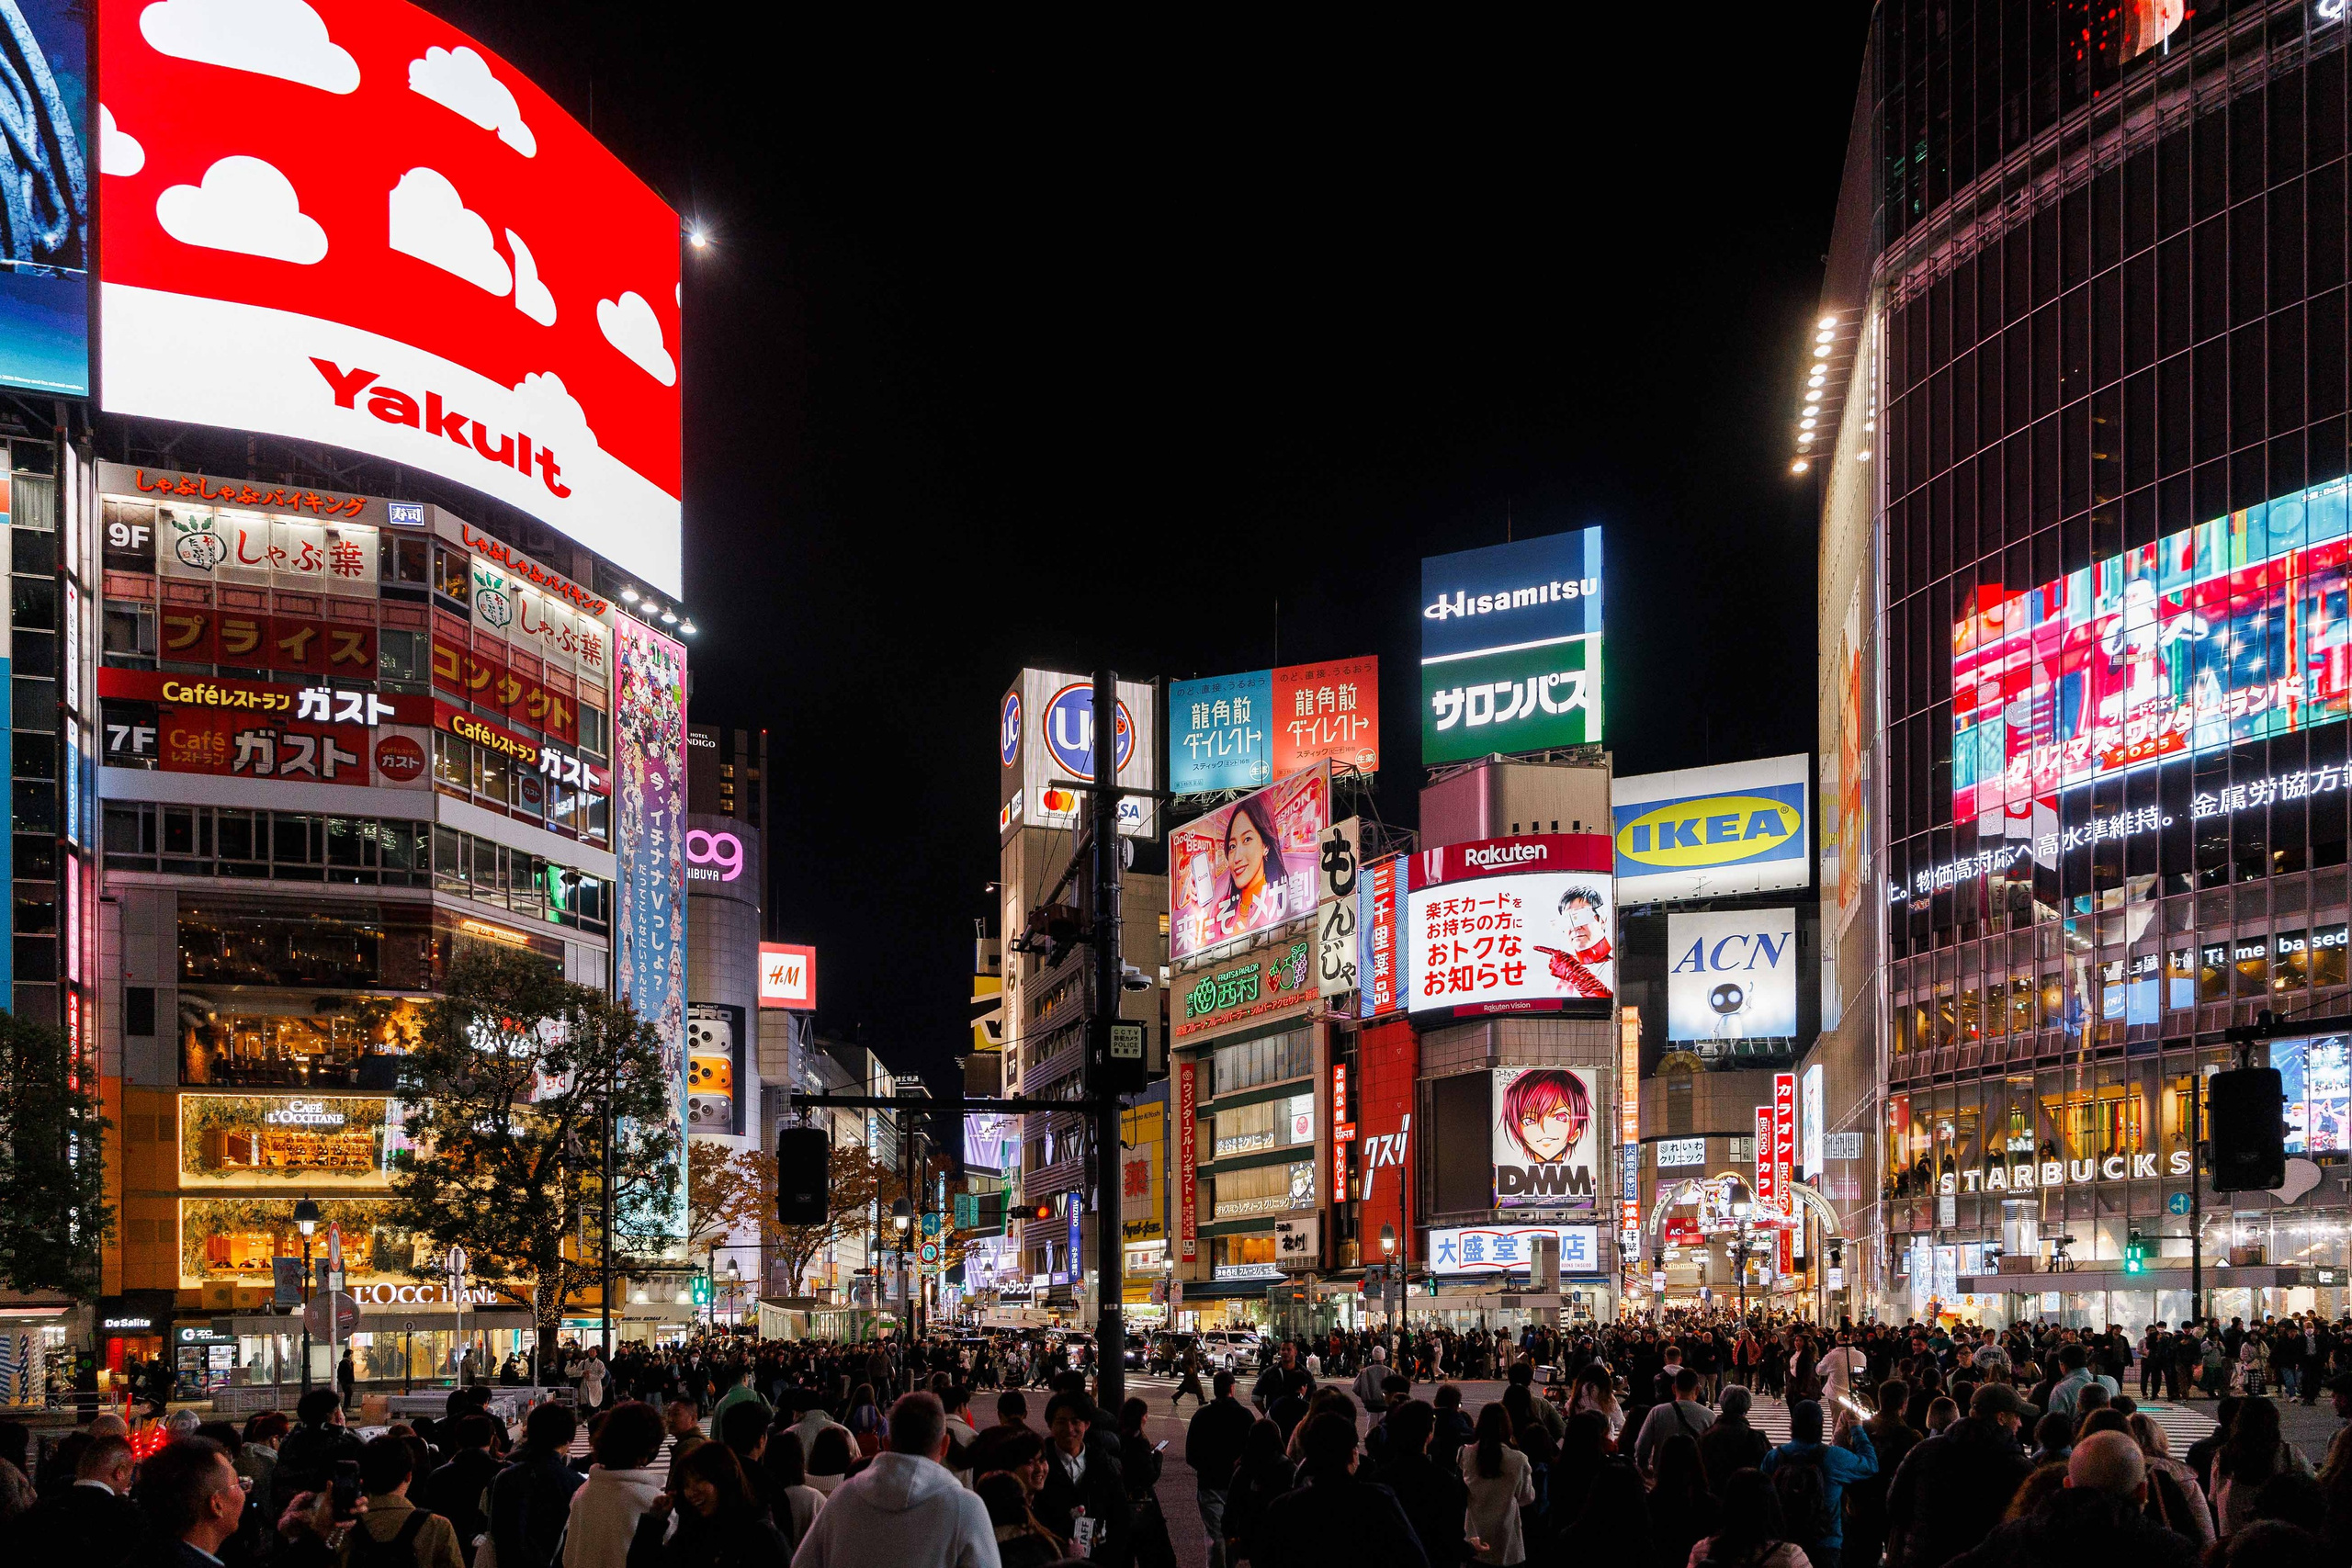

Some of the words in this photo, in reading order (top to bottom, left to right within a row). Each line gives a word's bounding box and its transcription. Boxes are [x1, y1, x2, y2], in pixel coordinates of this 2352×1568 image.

[308, 356, 571, 499] Yakult
[136, 469, 367, 517] しゃぶしゃぶバイキング
[391, 505, 422, 523] 寿司
[108, 523, 150, 548] 9F
[237, 529, 365, 578] しゃぶ葉
[462, 524, 608, 615] しゃぶしゃぶバイキング
[1424, 578, 1598, 620] Hisamitsu
[164, 615, 368, 667] プライス
[521, 598, 602, 667] しゃぶ葉
[433, 644, 573, 728] コンタクト
[1295, 682, 1357, 716] 龍角散
[1432, 670, 1590, 731] サロンパス
[298, 686, 395, 726] ガスト
[1192, 695, 1251, 729] 龍角散
[107, 725, 156, 753] 7F
[170, 729, 226, 751] Café
[687, 738, 716, 748] NDIGO
[1182, 727, 1262, 760] ダイレクト
[1286, 714, 1369, 747] ダイレクト
[233, 730, 357, 778] ガスト
[382, 755, 420, 770] ガスト
[2115, 739, 2170, 763] 2025
[540, 746, 600, 792] ガスト
[1116, 803, 1139, 818] SA
[1633, 808, 1788, 853] IKEA
[687, 829, 743, 882] 09
[1465, 843, 1547, 868] Rakuten
[687, 868, 719, 881] HIBUYA
[1321, 828, 1356, 987] もんじゃ
[1426, 892, 1522, 920] 楽天カードを
[1374, 868, 1391, 1006] 三千里薬品
[1427, 912, 1522, 940] お持ちの方に
[1428, 933, 1522, 967] おトクな
[1671, 931, 1792, 974] ACN
[2204, 942, 2266, 964] Time
[2279, 928, 2349, 953] based
[768, 964, 800, 987] H&M
[1217, 975, 1259, 1009] 西村
[1423, 961, 1527, 998] お知らせ
[1483, 1004, 1510, 1013] Rakuten
[1510, 1001, 1531, 1010] Vision
[1777, 1084, 1792, 1156] カラオケ
[1182, 1082, 1193, 1195] ウィンターフルーツギフト
[1670, 1142, 1703, 1153] れいわ
[1659, 1153, 1703, 1165] クリニック
[1940, 1151, 2191, 1194] STARBUCKS
[1497, 1164, 1594, 1197] DMM
[1438, 1234, 1586, 1266] 大盛堂店
